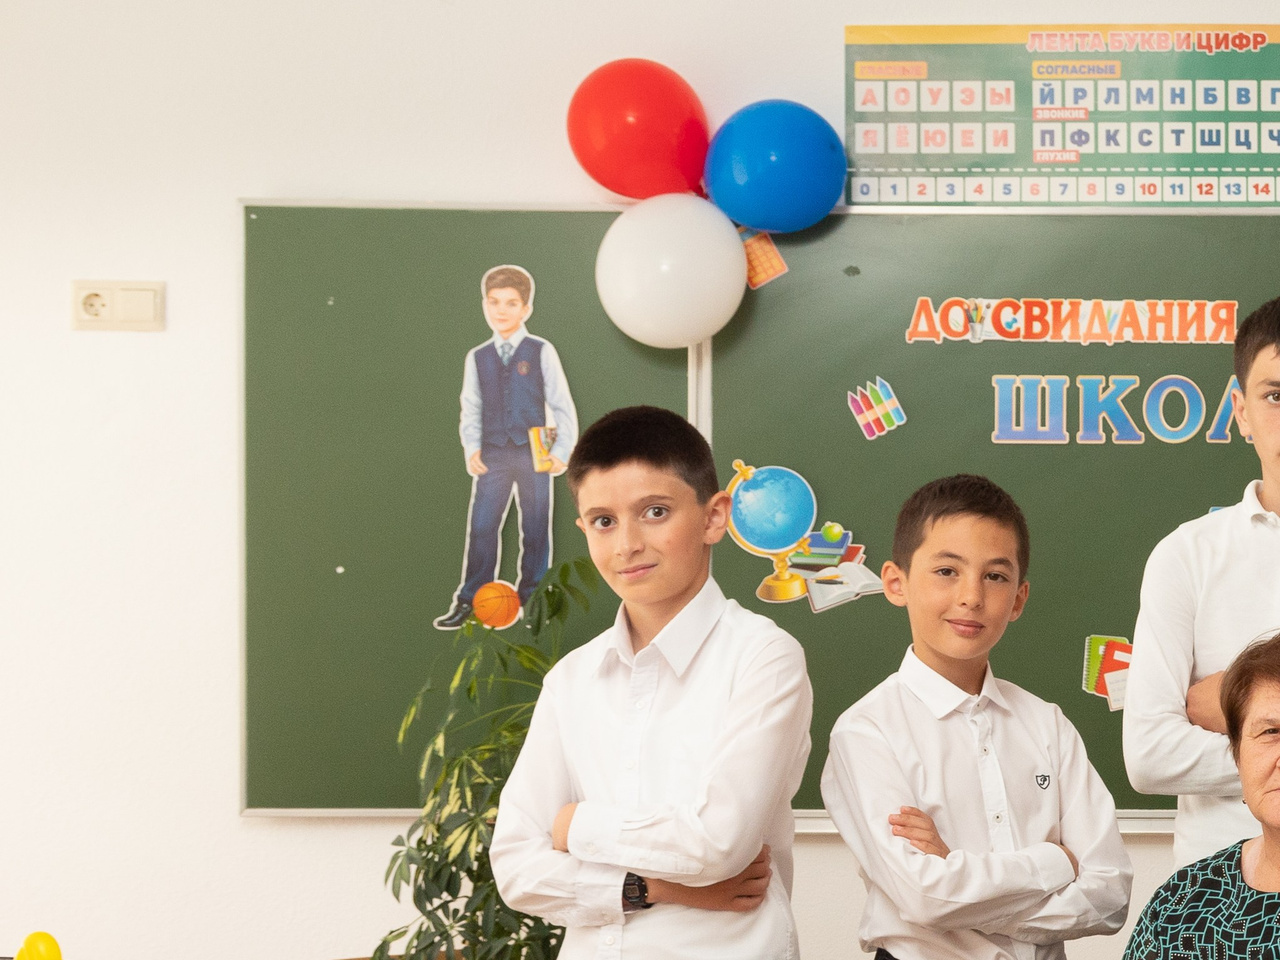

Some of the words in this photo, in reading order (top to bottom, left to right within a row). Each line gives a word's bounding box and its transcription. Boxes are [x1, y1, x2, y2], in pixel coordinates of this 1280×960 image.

[1027, 32, 1104, 51] ЛЕНТА
[1109, 32, 1171, 51] БУКВ
[1175, 32, 1191, 51] И
[1196, 32, 1267, 54] ЦИФР
[1036, 64, 1116, 76] СОГЛАСНЫЕ
[861, 89, 877, 105] А
[895, 88, 910, 105] О
[928, 88, 942, 105] У
[990, 87, 1011, 105] Ы
[1039, 83, 1055, 105] Й
[1073, 87, 1087, 105] Р
[1104, 87, 1120, 105] Л
[1136, 87, 1154, 105] М
[1170, 87, 1185, 104] Н
[1203, 87, 1218, 105] Б
[1236, 87, 1251, 105] В
[1035, 109, 1086, 120] ЗВОНКИЕ
[863, 130, 877, 146] Я
[924, 130, 946, 147] Ю
[961, 130, 974, 147] Е
[993, 130, 1008, 147] И
[1040, 129, 1055, 147] П
[1070, 129, 1090, 147] Ф
[1105, 129, 1120, 146] К
[1138, 129, 1153, 147] С
[1170, 129, 1185, 146] Т
[1200, 129, 1221, 146] Ш
[1235, 129, 1252, 150] Ц
[1036, 151, 1077, 161] ГЛУХИЕ
[860, 183, 870, 195] 0
[890, 184, 897, 195] 1
[917, 183, 926, 195] 2
[946, 183, 955, 195] 3
[973, 183, 984, 195] 4
[1003, 183, 1012, 195] 5
[1030, 184, 1040, 195] 6
[1059, 183, 1068, 195] 7
[1087, 183, 1096, 195] 8
[1115, 183, 1125, 195] 9
[1140, 183, 1157, 195] 10
[1169, 183, 1184, 195] 11
[1196, 183, 1214, 195] 12
[1224, 183, 1242, 195] 13
[1252, 183, 1270, 195] 14
[906, 297, 971, 343] ДО
[990, 298, 1238, 345] СВИДАНИЯ
